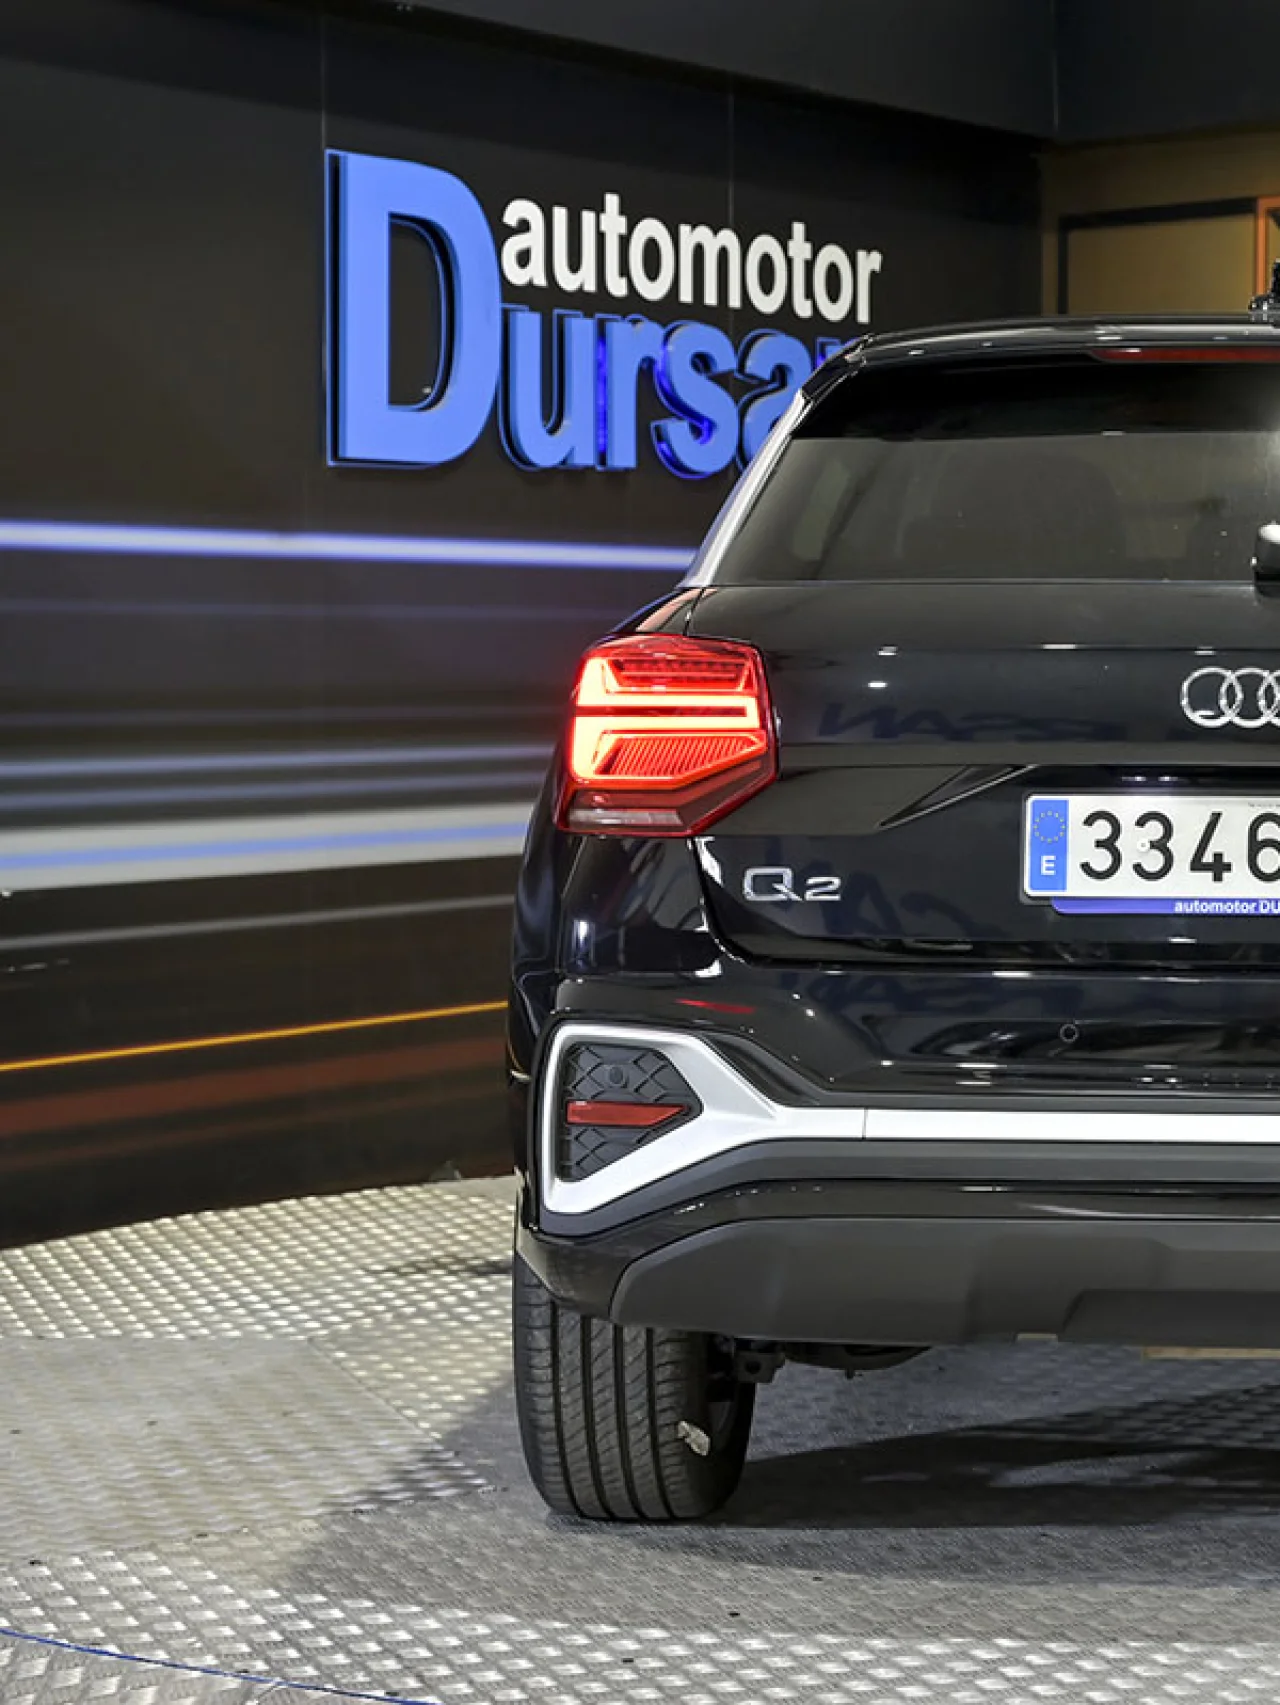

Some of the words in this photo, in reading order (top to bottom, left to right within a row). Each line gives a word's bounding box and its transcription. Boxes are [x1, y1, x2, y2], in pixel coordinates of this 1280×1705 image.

[502, 193, 883, 324] automotor
[324, 148, 860, 480] Dursa
[744, 867, 842, 902] Q2
[1040, 856, 1056, 876] E
